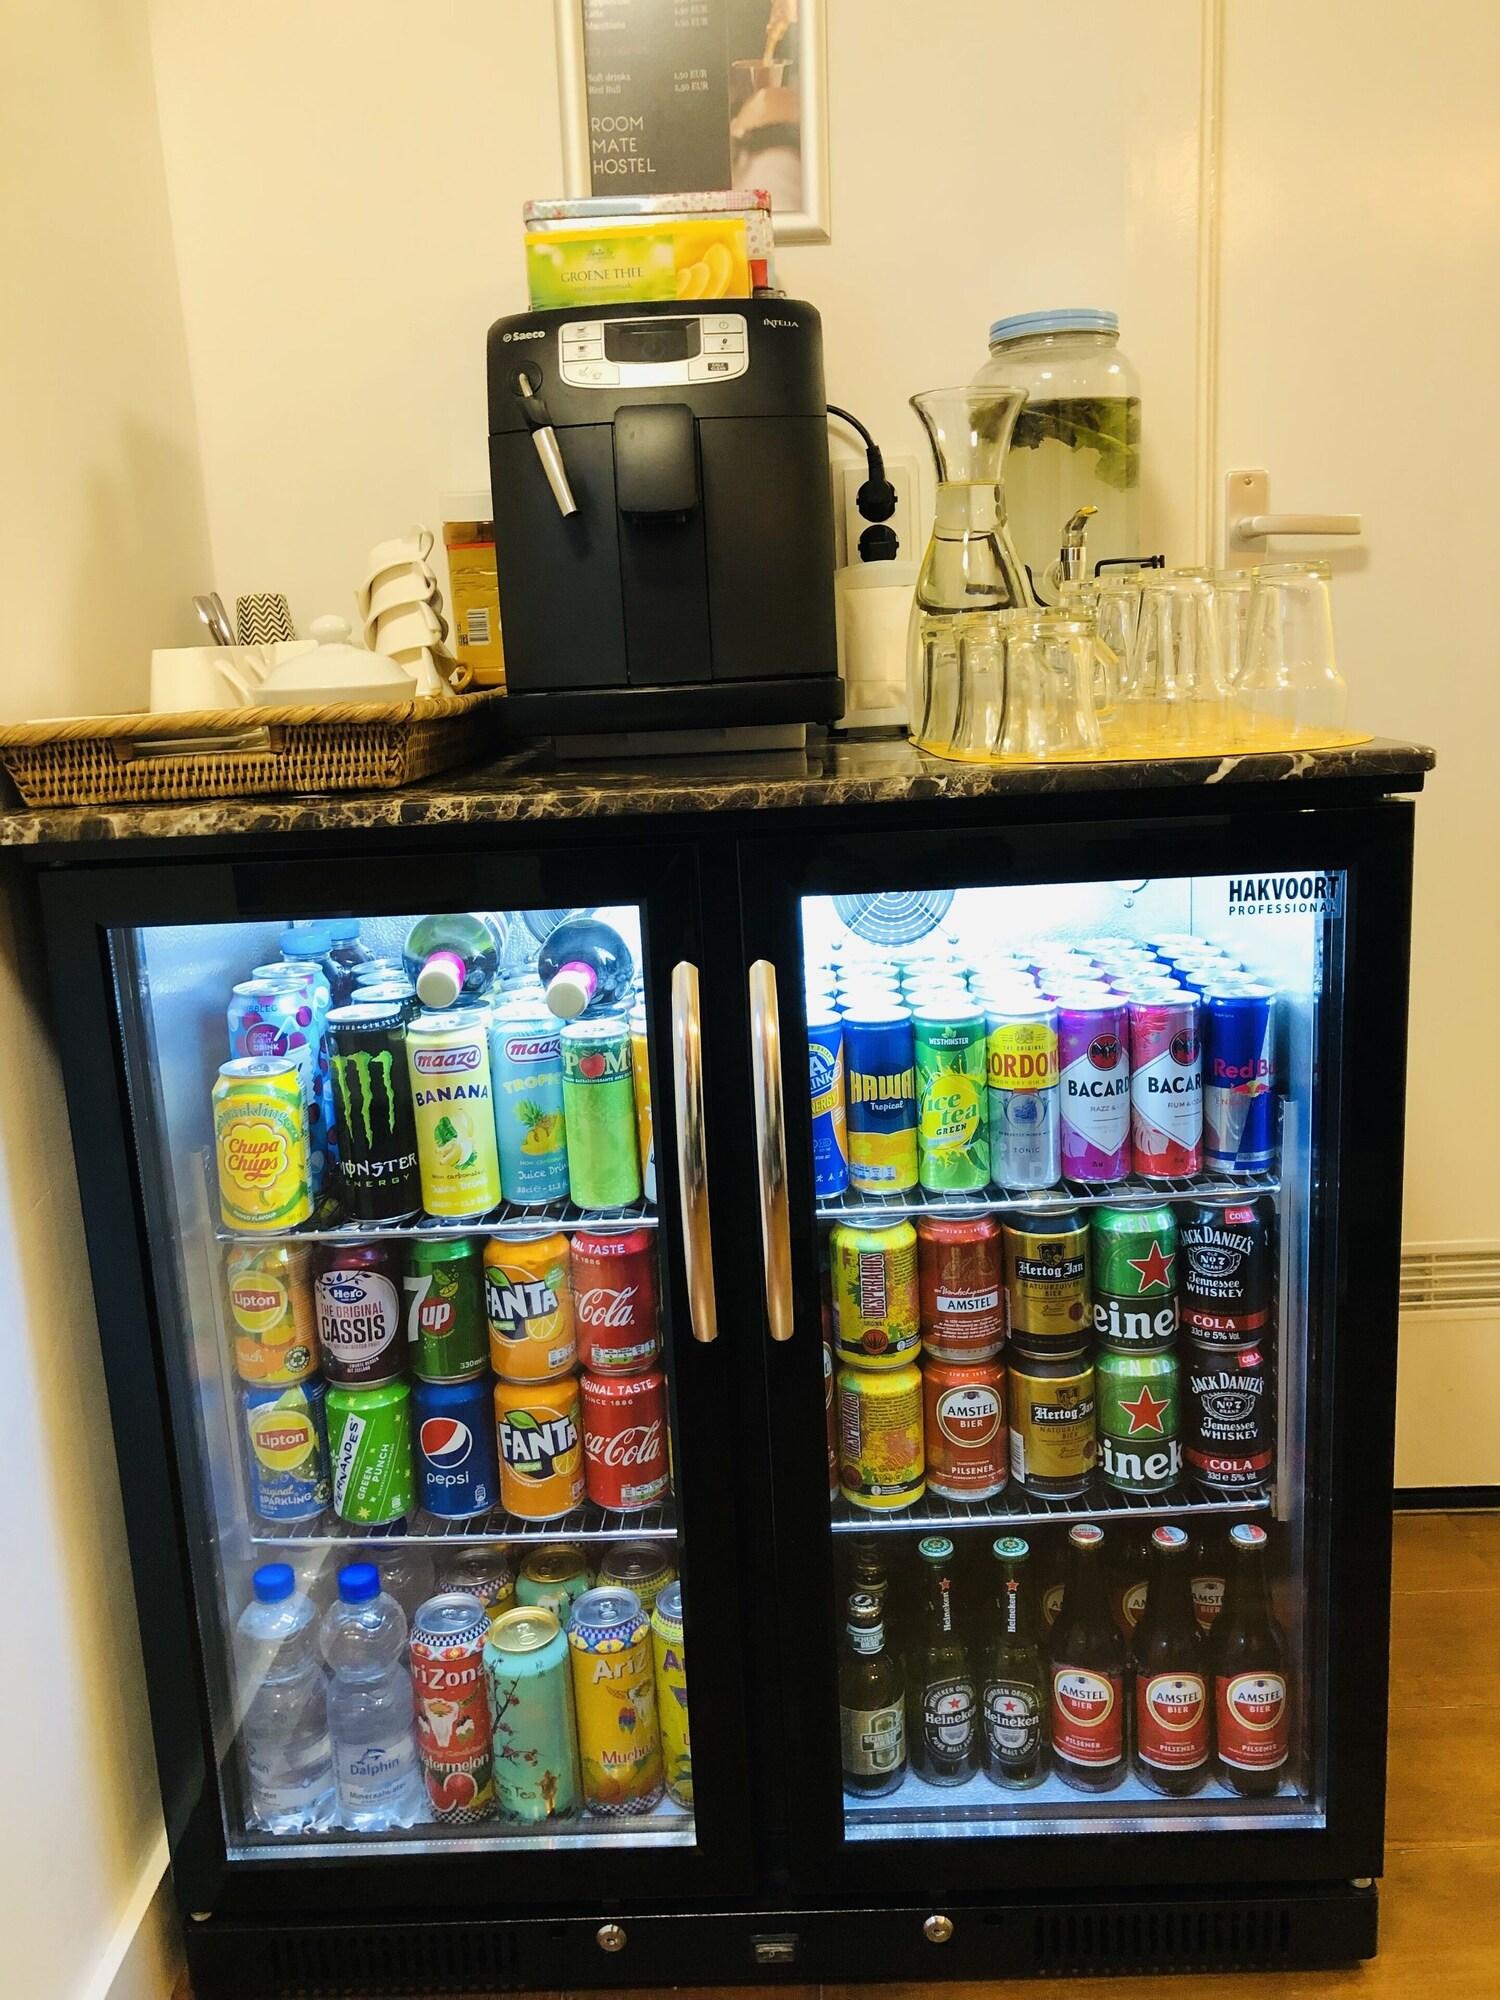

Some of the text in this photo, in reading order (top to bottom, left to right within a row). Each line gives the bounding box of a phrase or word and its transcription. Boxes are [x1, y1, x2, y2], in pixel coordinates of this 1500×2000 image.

[591, 116, 644, 132] ROOM
[592, 138, 637, 154] MATE
[593, 158, 656, 174] HOSTEL
[561, 269, 609, 283] GROENE
[513, 330, 545, 341] Saeco
[1229, 876, 1339, 902] HAKVOORT
[1229, 903, 1336, 916] PROFESSIONAL
[929, 1037, 969, 1046] WESTMINSTER
[417, 1050, 477, 1069] maaza
[987, 1051, 1058, 1078] ORDON
[1214, 1058, 1253, 1079] Red
[415, 1084, 488, 1107] BANANA
[927, 1089, 961, 1112] ice
[870, 1101, 904, 1112] Tropical
[941, 1104, 977, 1126] tea
[936, 1123, 967, 1136] GREEN
[229, 1139, 279, 1157] Chupa
[228, 1154, 278, 1181] Chups
[517, 1170, 546, 1180] Juice
[1229, 1211, 1250, 1220] COLA
[1180, 1228, 1203, 1247] JACK
[1203, 1225, 1254, 1255] DANIEL'S
[588, 1243, 626, 1256] TASTE
[1018, 1261, 1084, 1278] Hertog Jan
[1217, 1257, 1226, 1266] 7
[860, 1253, 887, 1318] DESPERADOS
[1188, 1271, 1240, 1288] Tennessee
[333, 1288, 363, 1299] Hero
[1186, 1281, 1244, 1298] WHISKEY
[234, 1293, 276, 1309] Lipton
[485, 1280, 558, 1320] FANTA
[579, 1284, 639, 1328] Cola
[947, 1297, 991, 1311] AMSTEL
[321, 1301, 384, 1318] THE ORIGINAL
[403, 1275, 451, 1343] 7 up
[321, 1314, 386, 1344] CASSIS
[1193, 1314, 1235, 1329] COLA
[617, 1379, 655, 1394] TASTE
[1190, 1372, 1264, 1395] JACK DANIEL'S
[585, 1394, 606, 1406] SINCE
[1234, 1401, 1242, 1409] 7
[947, 1402, 994, 1416] AMSTEL
[1034, 1406, 1078, 1422] Hertog
[960, 1419, 984, 1428] BIER
[1203, 1416, 1255, 1431] Tennessee
[259, 1430, 305, 1449] Lipton
[499, 1416, 578, 1460] FANTA
[1200, 1428, 1258, 1441] WHISKEY
[372, 1444, 390, 1483] PUNCH
[951, 1464, 994, 1475] PILSENER
[1209, 1459, 1252, 1471] COLA
[357, 1465, 374, 1500] GREEN
[426, 1471, 469, 1488] pepsi
[259, 1492, 312, 1506] SPARKLING
[942, 1590, 952, 1631] Heineken
[1007, 1593, 1016, 1633] Heineken
[1200, 1605, 1221, 1613] BIER
[1062, 1684, 1105, 1700] AMSTEL
[1156, 1691, 1199, 1703] AMSTEL
[1237, 1689, 1281, 1703] AMSTEL
[1071, 1699, 1093, 1710] BIER
[1167, 1706, 1189, 1714] BIER
[1249, 1705, 1271, 1713] BIER
[984, 1706, 1039, 1727] Heineken
[1065, 1735, 1101, 1748] PILSENER
[1159, 1744, 1196, 1752] PILSENER
[1241, 1743, 1277, 1752] PILSENER
[1001, 1748, 1018, 1756] MALT
[350, 1757, 400, 1776] Dalphin
[512, 1785, 537, 1799] Tea
